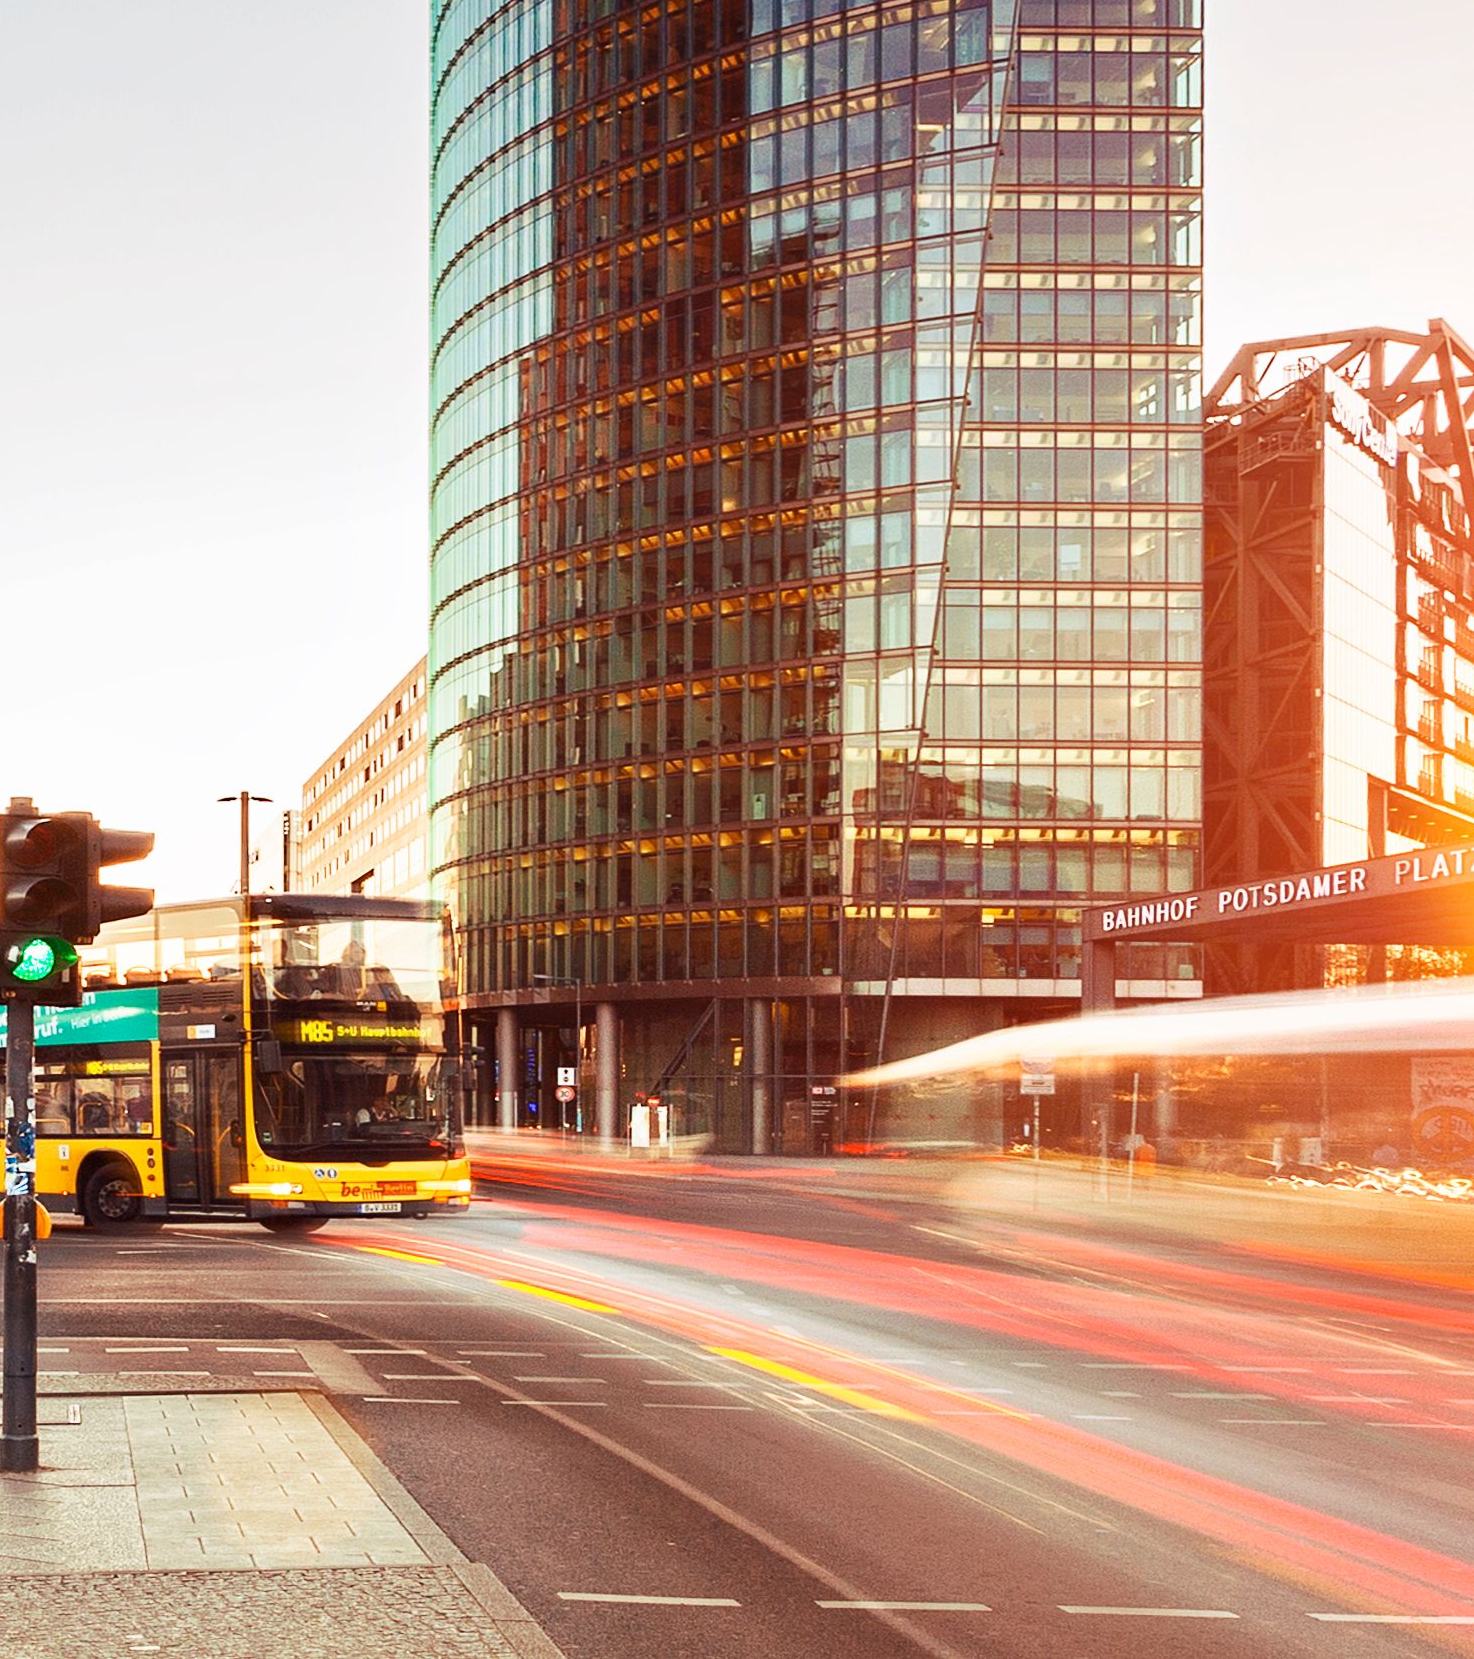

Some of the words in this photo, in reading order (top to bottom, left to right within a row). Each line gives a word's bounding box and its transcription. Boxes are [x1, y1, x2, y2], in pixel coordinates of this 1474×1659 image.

[1102, 895, 1199, 932] BAHNHOF
[1218, 867, 1366, 914] POTSDAMER
[300, 1019, 334, 1042] M85
[337, 1025, 358, 1037] S+U
[360, 1025, 432, 1038] Hauptbahnhof
[341, 1181, 361, 1197] be
